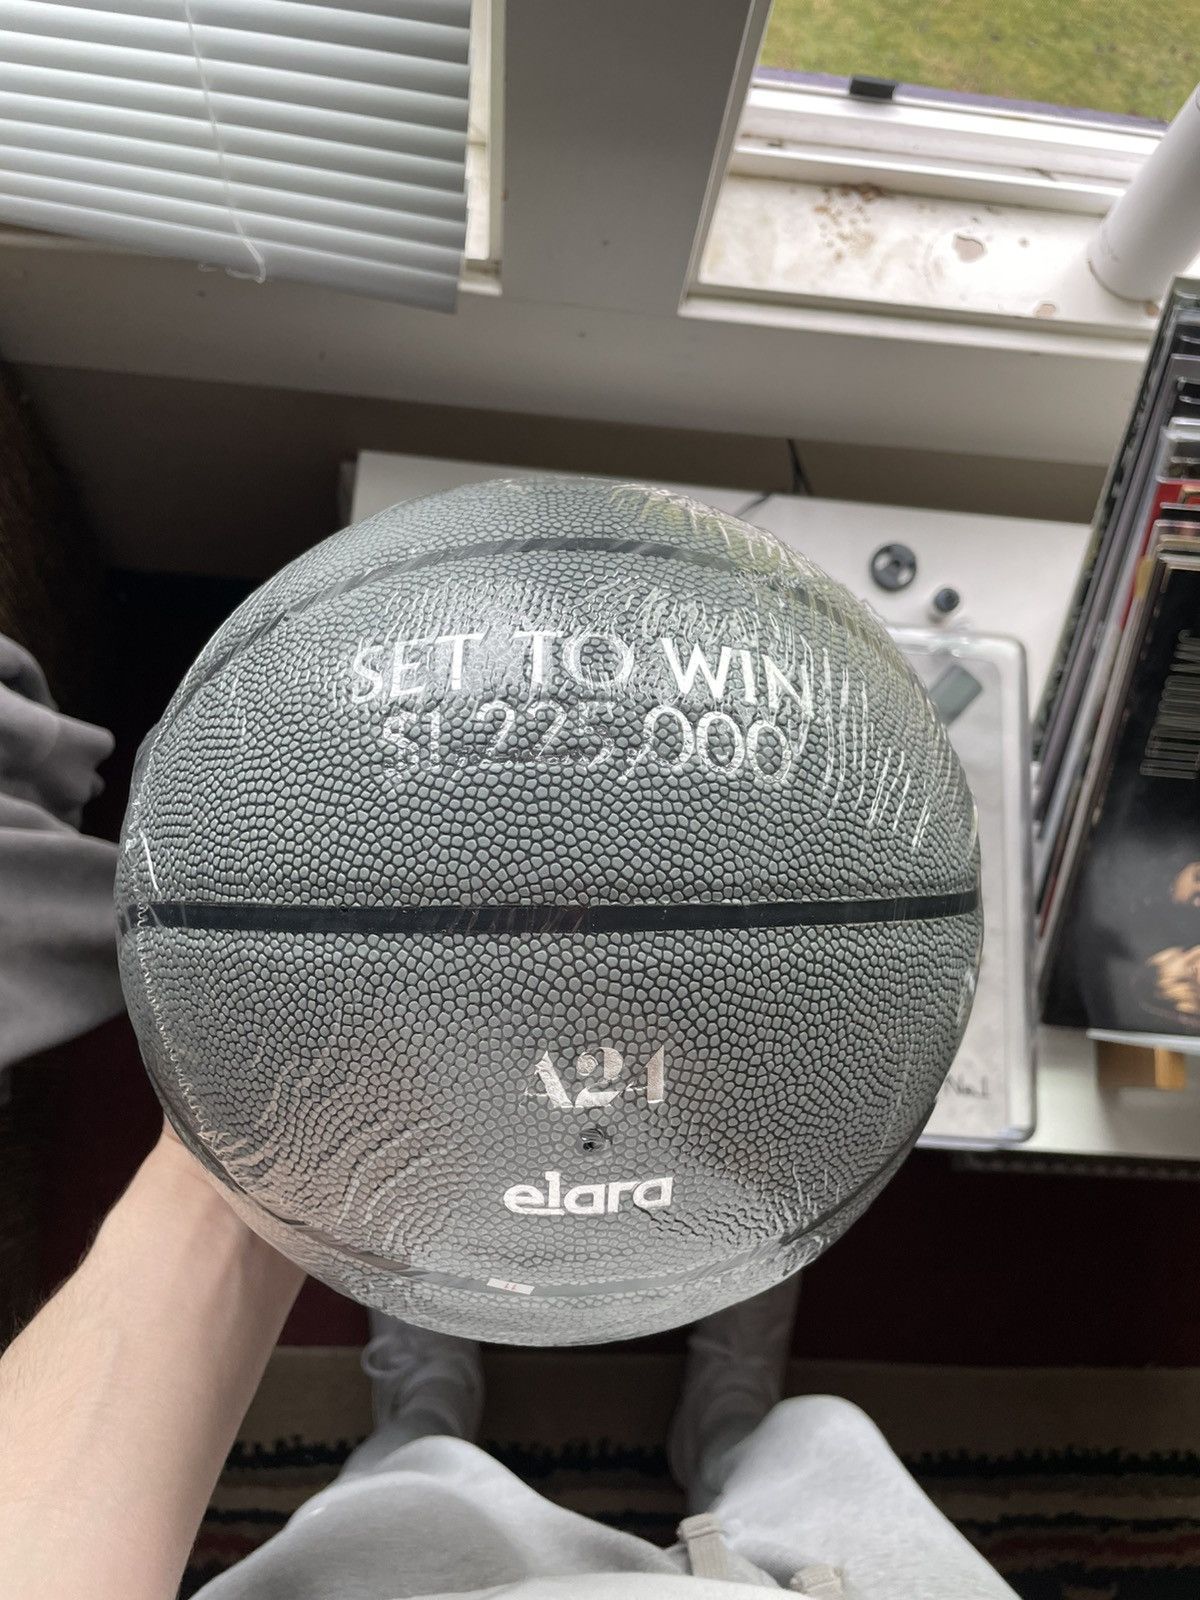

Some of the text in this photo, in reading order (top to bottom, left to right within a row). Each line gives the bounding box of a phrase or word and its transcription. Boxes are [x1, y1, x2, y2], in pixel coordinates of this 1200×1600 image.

[351, 629, 814, 720] SET TO WIN
[503, 1171, 673, 1216] elara
